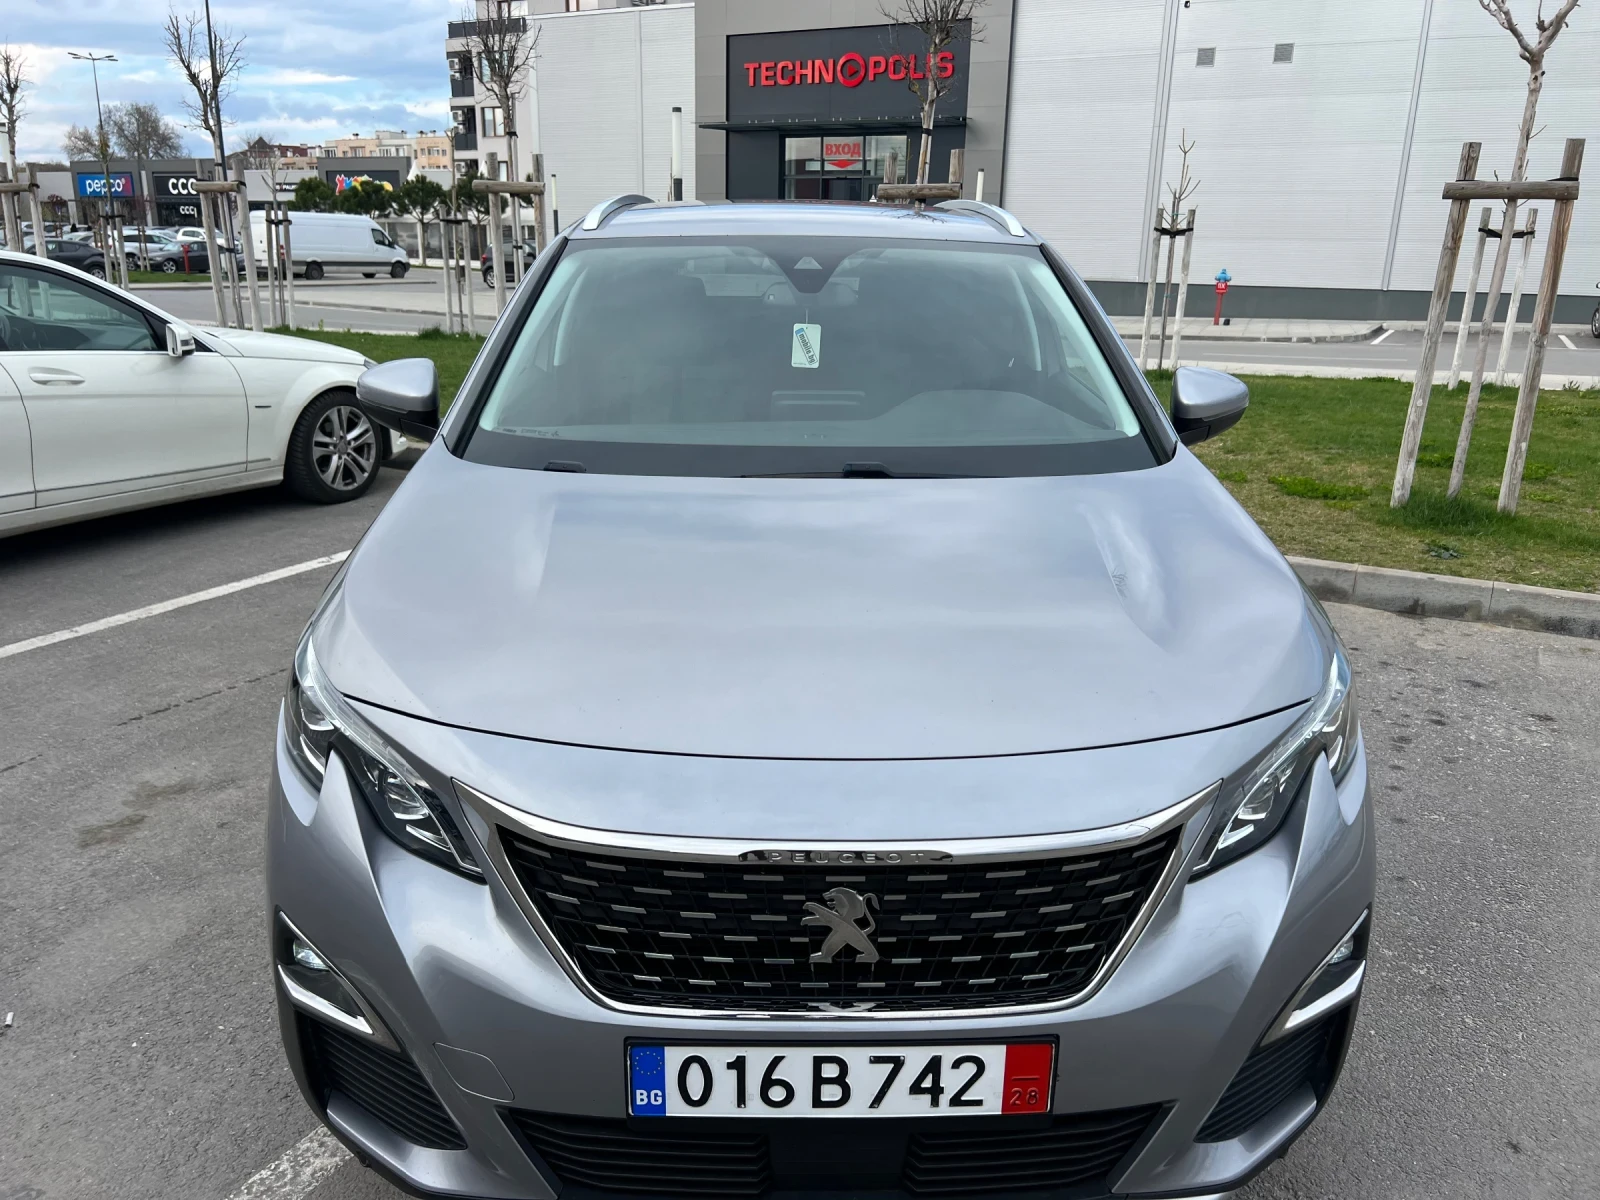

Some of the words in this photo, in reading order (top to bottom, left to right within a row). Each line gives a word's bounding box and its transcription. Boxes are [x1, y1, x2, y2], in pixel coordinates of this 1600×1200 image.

[744, 51, 955, 88] TECHNOPOLIS
[825, 142, 861, 157] ВХОД
[168, 178, 197, 195] CCC
[799, 333, 816, 364] mobile.bg
[768, 852, 924, 863] PEUGEOT
[635, 1089, 663, 1105] BG
[1009, 1087, 1039, 1105] 28
